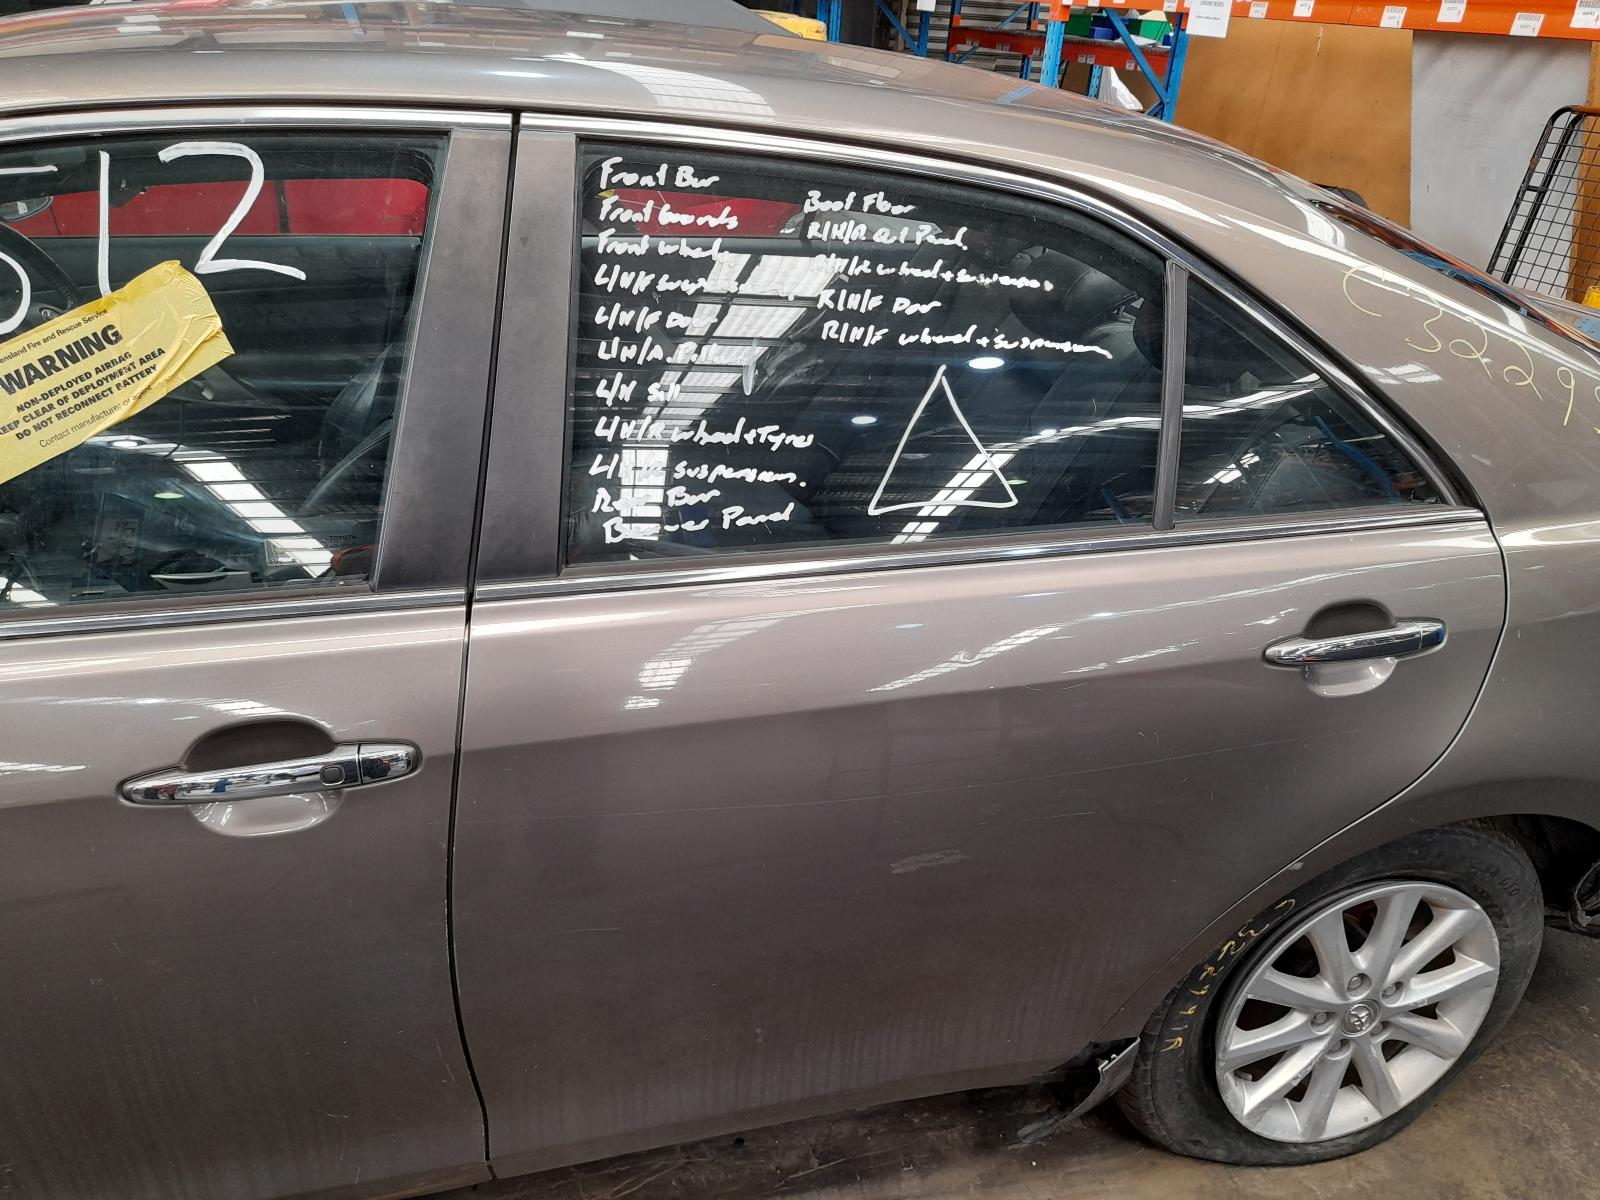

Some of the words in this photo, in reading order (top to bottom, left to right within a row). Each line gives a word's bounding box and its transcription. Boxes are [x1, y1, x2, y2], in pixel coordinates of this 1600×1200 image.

[600, 157, 668, 189] Front
[600, 195, 655, 222] Front
[597, 228, 650, 256] Front
[27, 336, 42, 351] Fire
[42, 331, 56, 346] and
[56, 319, 83, 337] Rescue
[82, 308, 108, 325] Service
[0, 324, 124, 396] WARNING
[16, 371, 93, 413] NON-DEPLOYED
[95, 351, 132, 376] AIRBAG
[16, 429, 32, 441] DO
[34, 417, 54, 433] NOT
[56, 389, 114, 421] RECONNECT
[117, 364, 158, 391] BATTERY
[22, 402, 56, 424] CLEAR
[57, 396, 70, 407] OF
[72, 364, 137, 400] DEPLOYMENT
[139, 347, 166, 365] AREA
[39, 427, 71, 448] Contact
